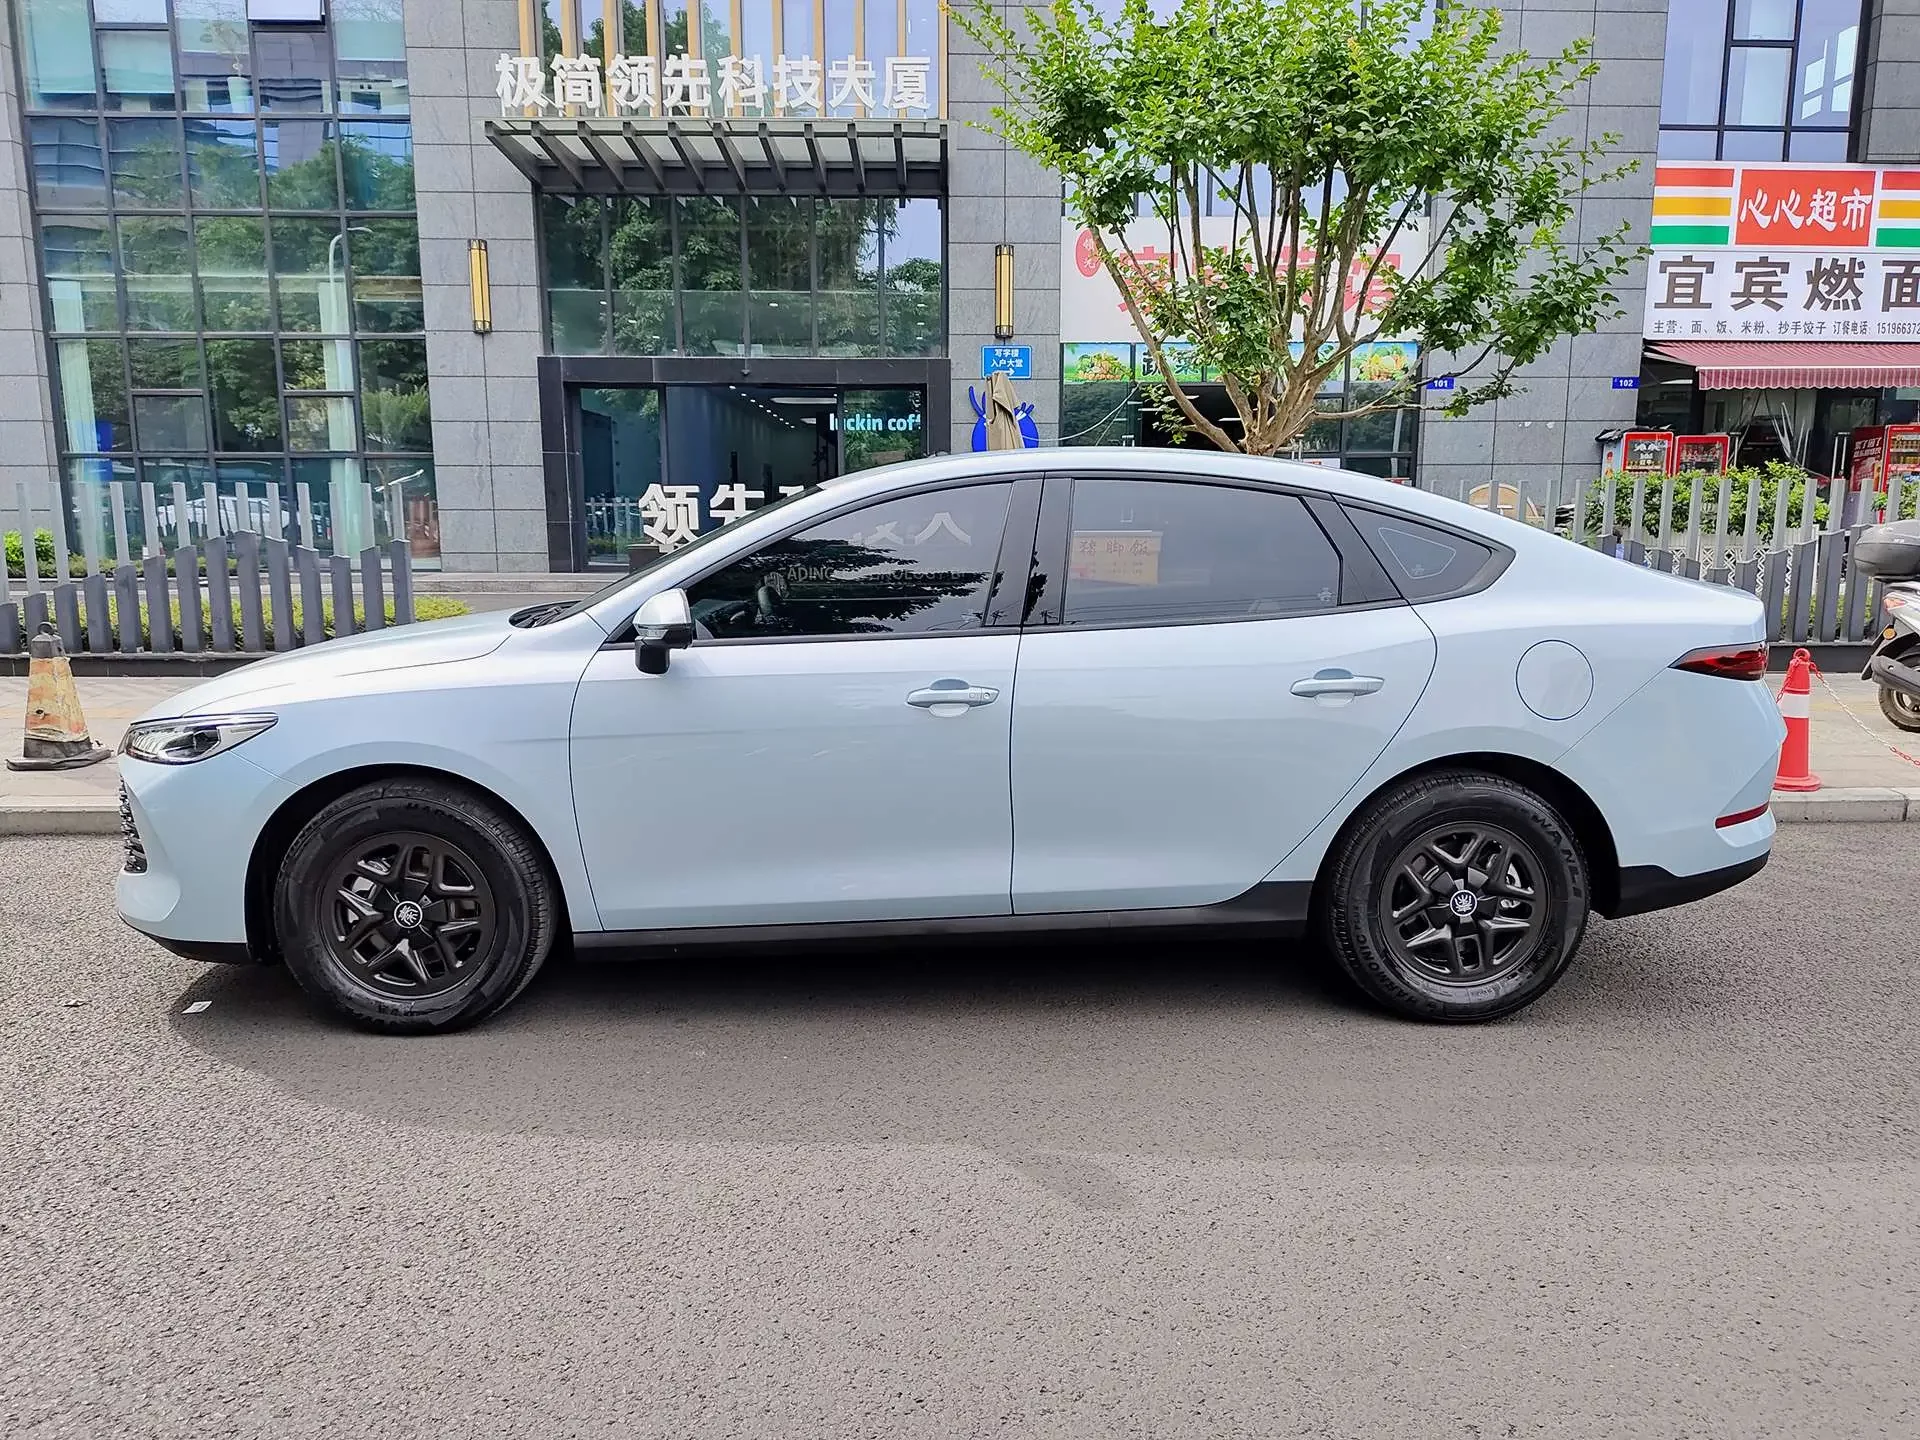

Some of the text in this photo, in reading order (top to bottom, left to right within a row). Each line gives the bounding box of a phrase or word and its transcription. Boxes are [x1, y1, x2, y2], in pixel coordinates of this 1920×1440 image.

[494, 53, 932, 110] 极简领先科技大厦
[1740, 187, 1872, 232] 心心超市
[1654, 255, 1920, 312] 宜宾燃面
[990, 359, 1024, 368] 入户大堂
[1433, 380, 1448, 388] 101
[1619, 379, 1633, 387] 102
